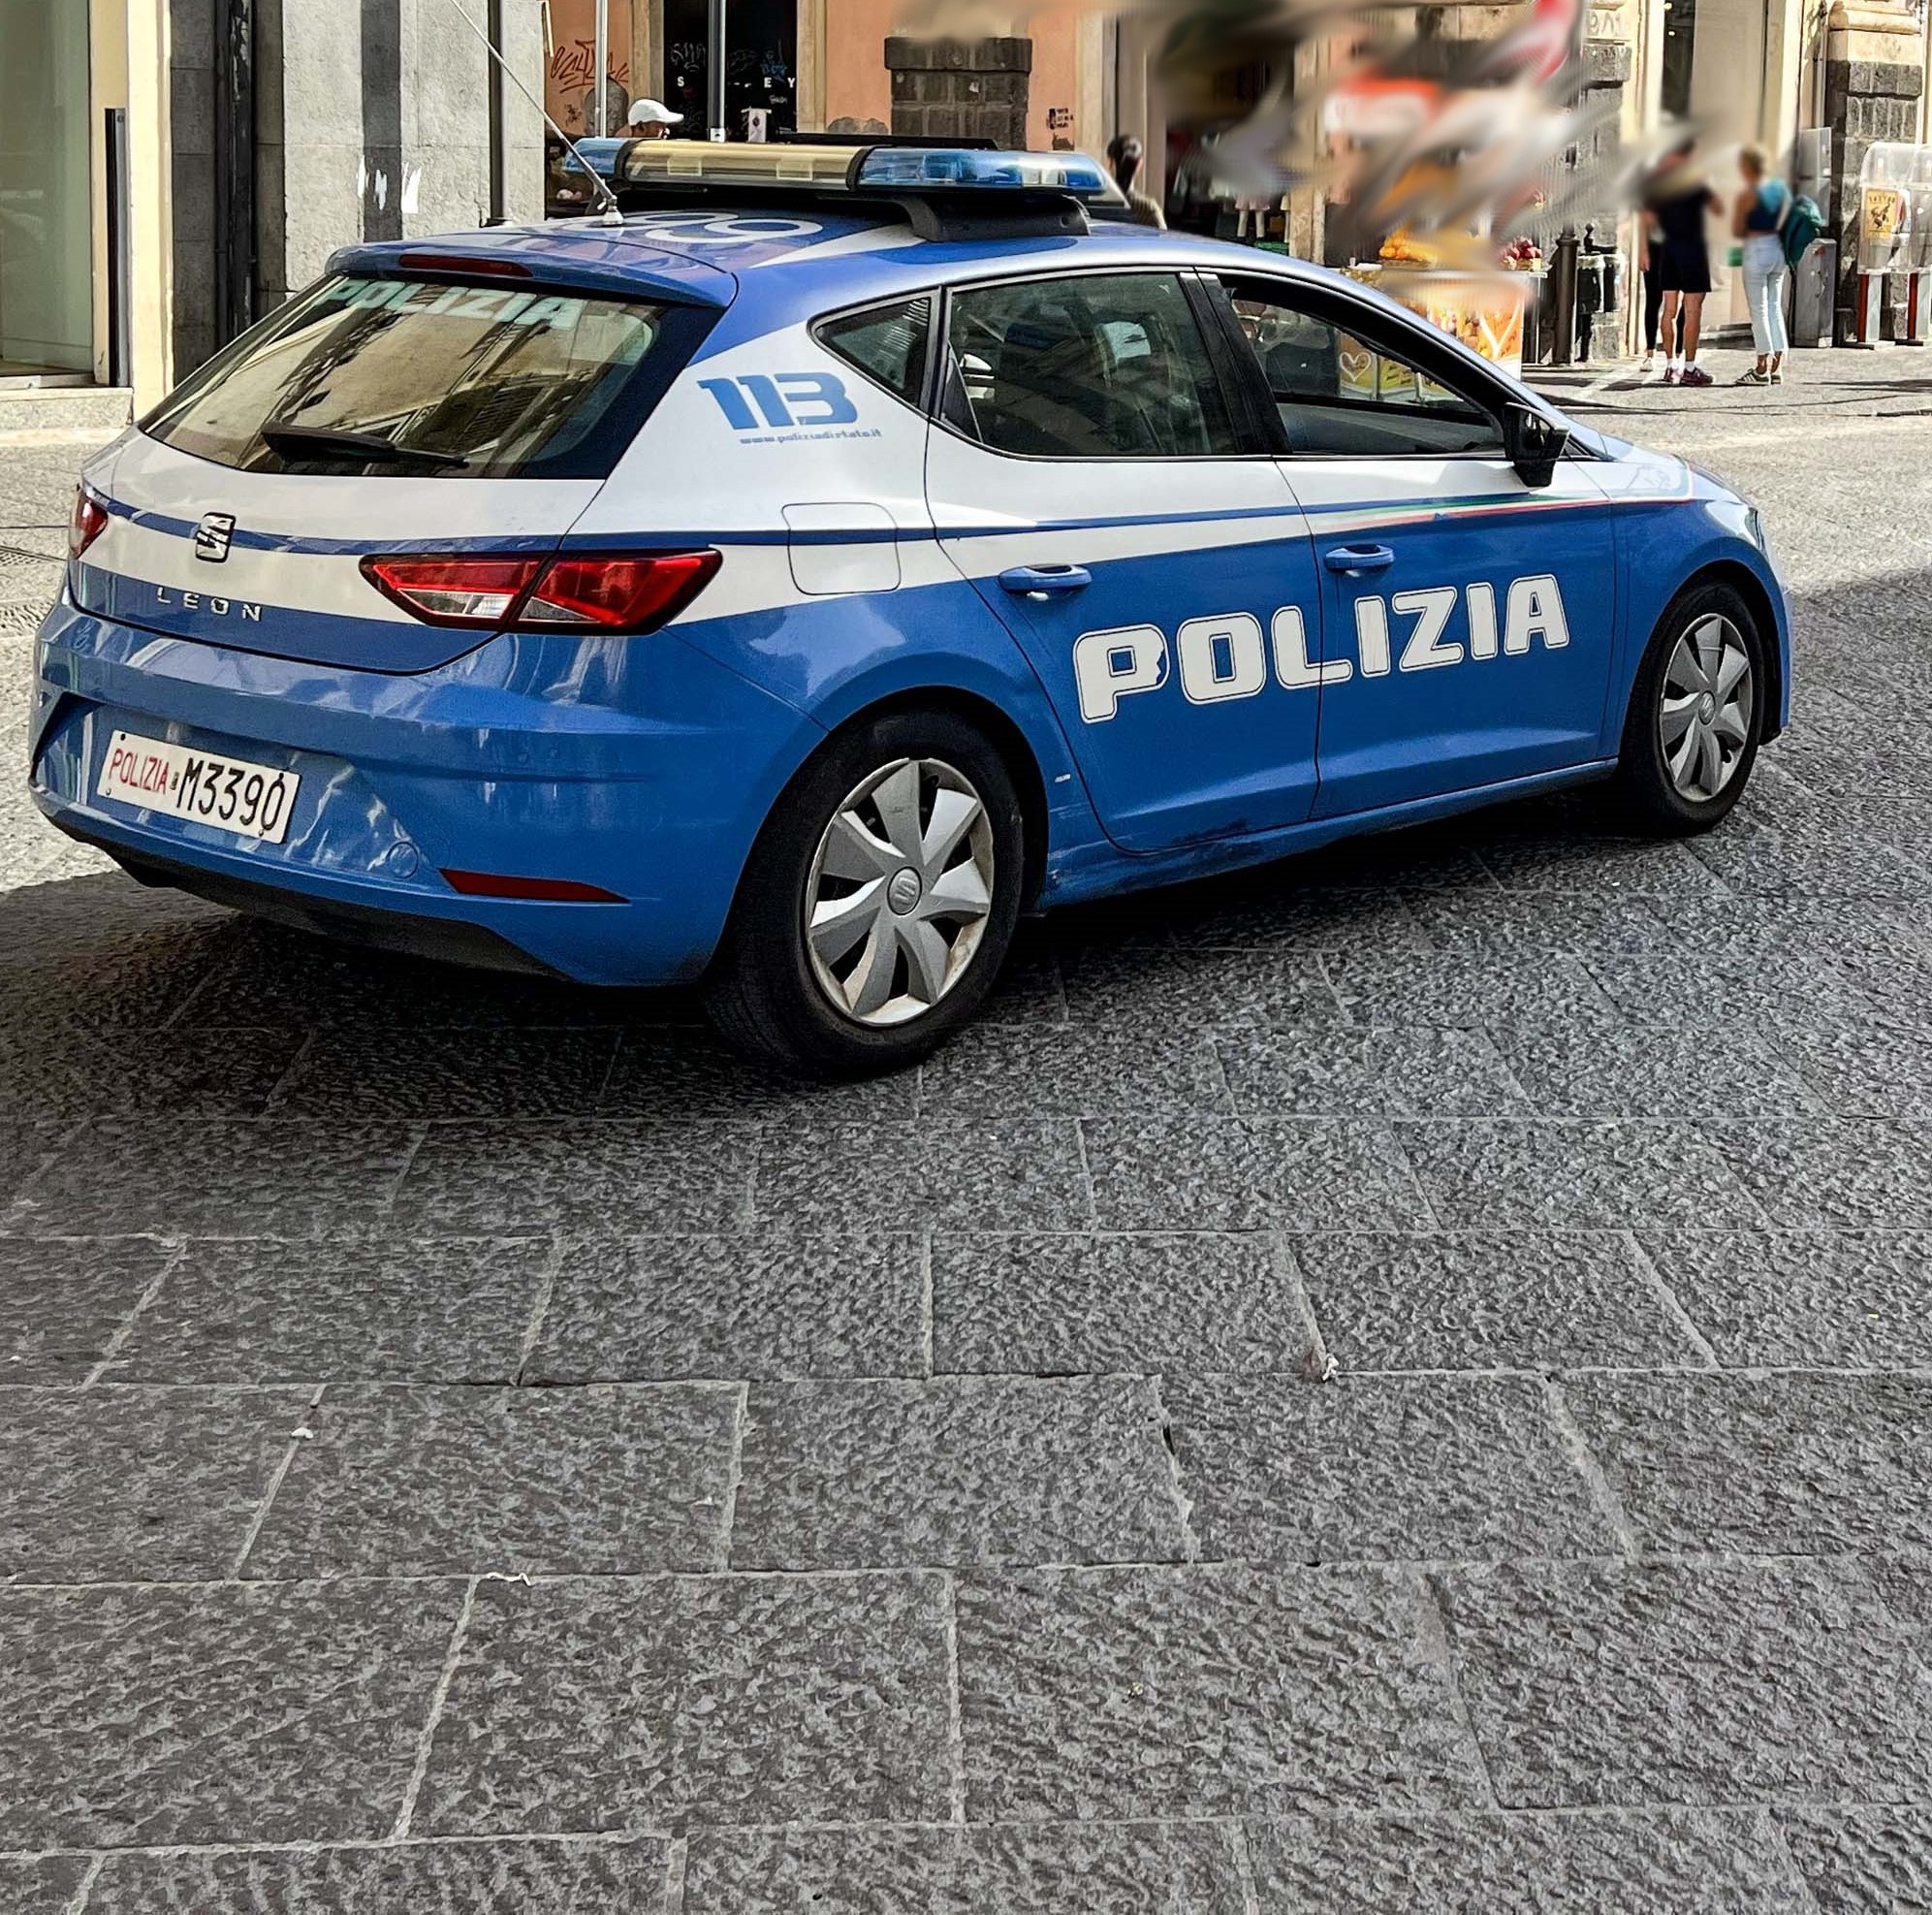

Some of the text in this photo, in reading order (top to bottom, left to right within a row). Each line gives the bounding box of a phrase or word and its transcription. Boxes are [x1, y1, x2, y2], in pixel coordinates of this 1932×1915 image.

[313, 278, 588, 331] POLIZIA
[696, 372, 858, 431] 113
[157, 586, 263, 622] LEON
[1073, 573, 1570, 724] POLIZIA
[108, 748, 286, 831] POLIZIA M3390
